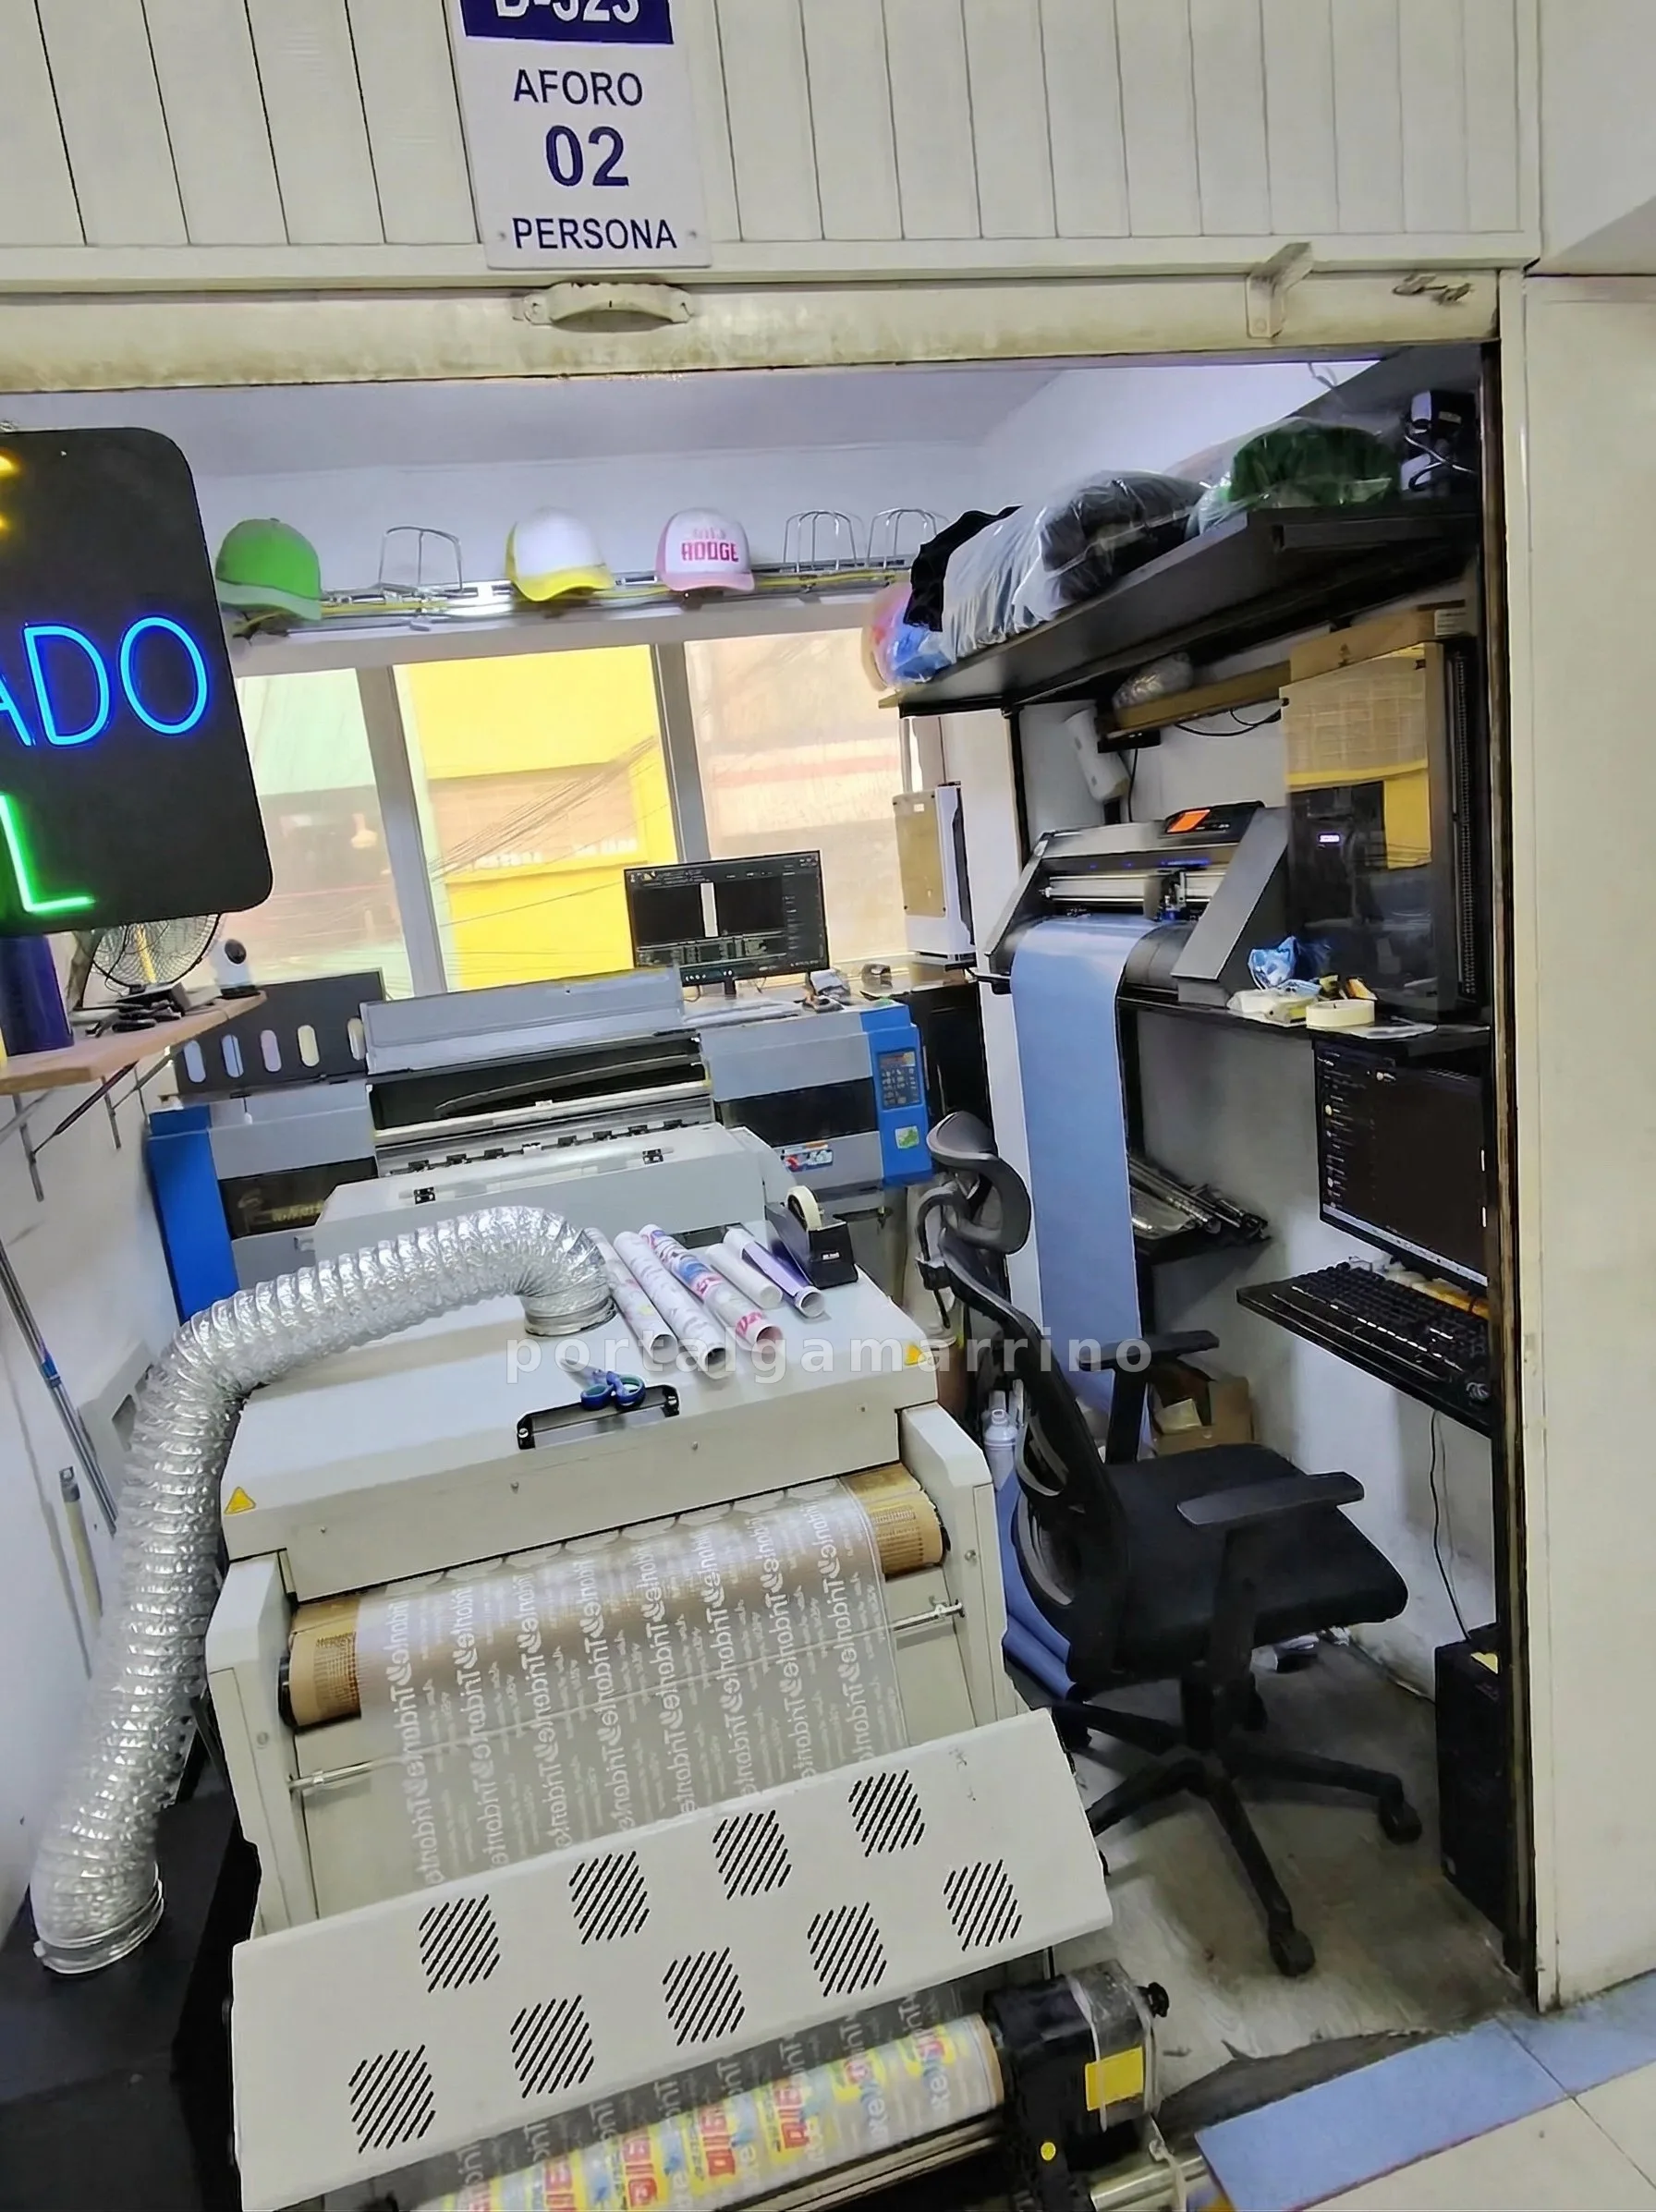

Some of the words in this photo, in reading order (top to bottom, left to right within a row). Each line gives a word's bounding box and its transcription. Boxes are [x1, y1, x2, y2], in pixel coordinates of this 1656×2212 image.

[514, 69, 643, 106] AFORO
[545, 126, 629, 187] 02
[512, 218, 677, 249] PERSONA
